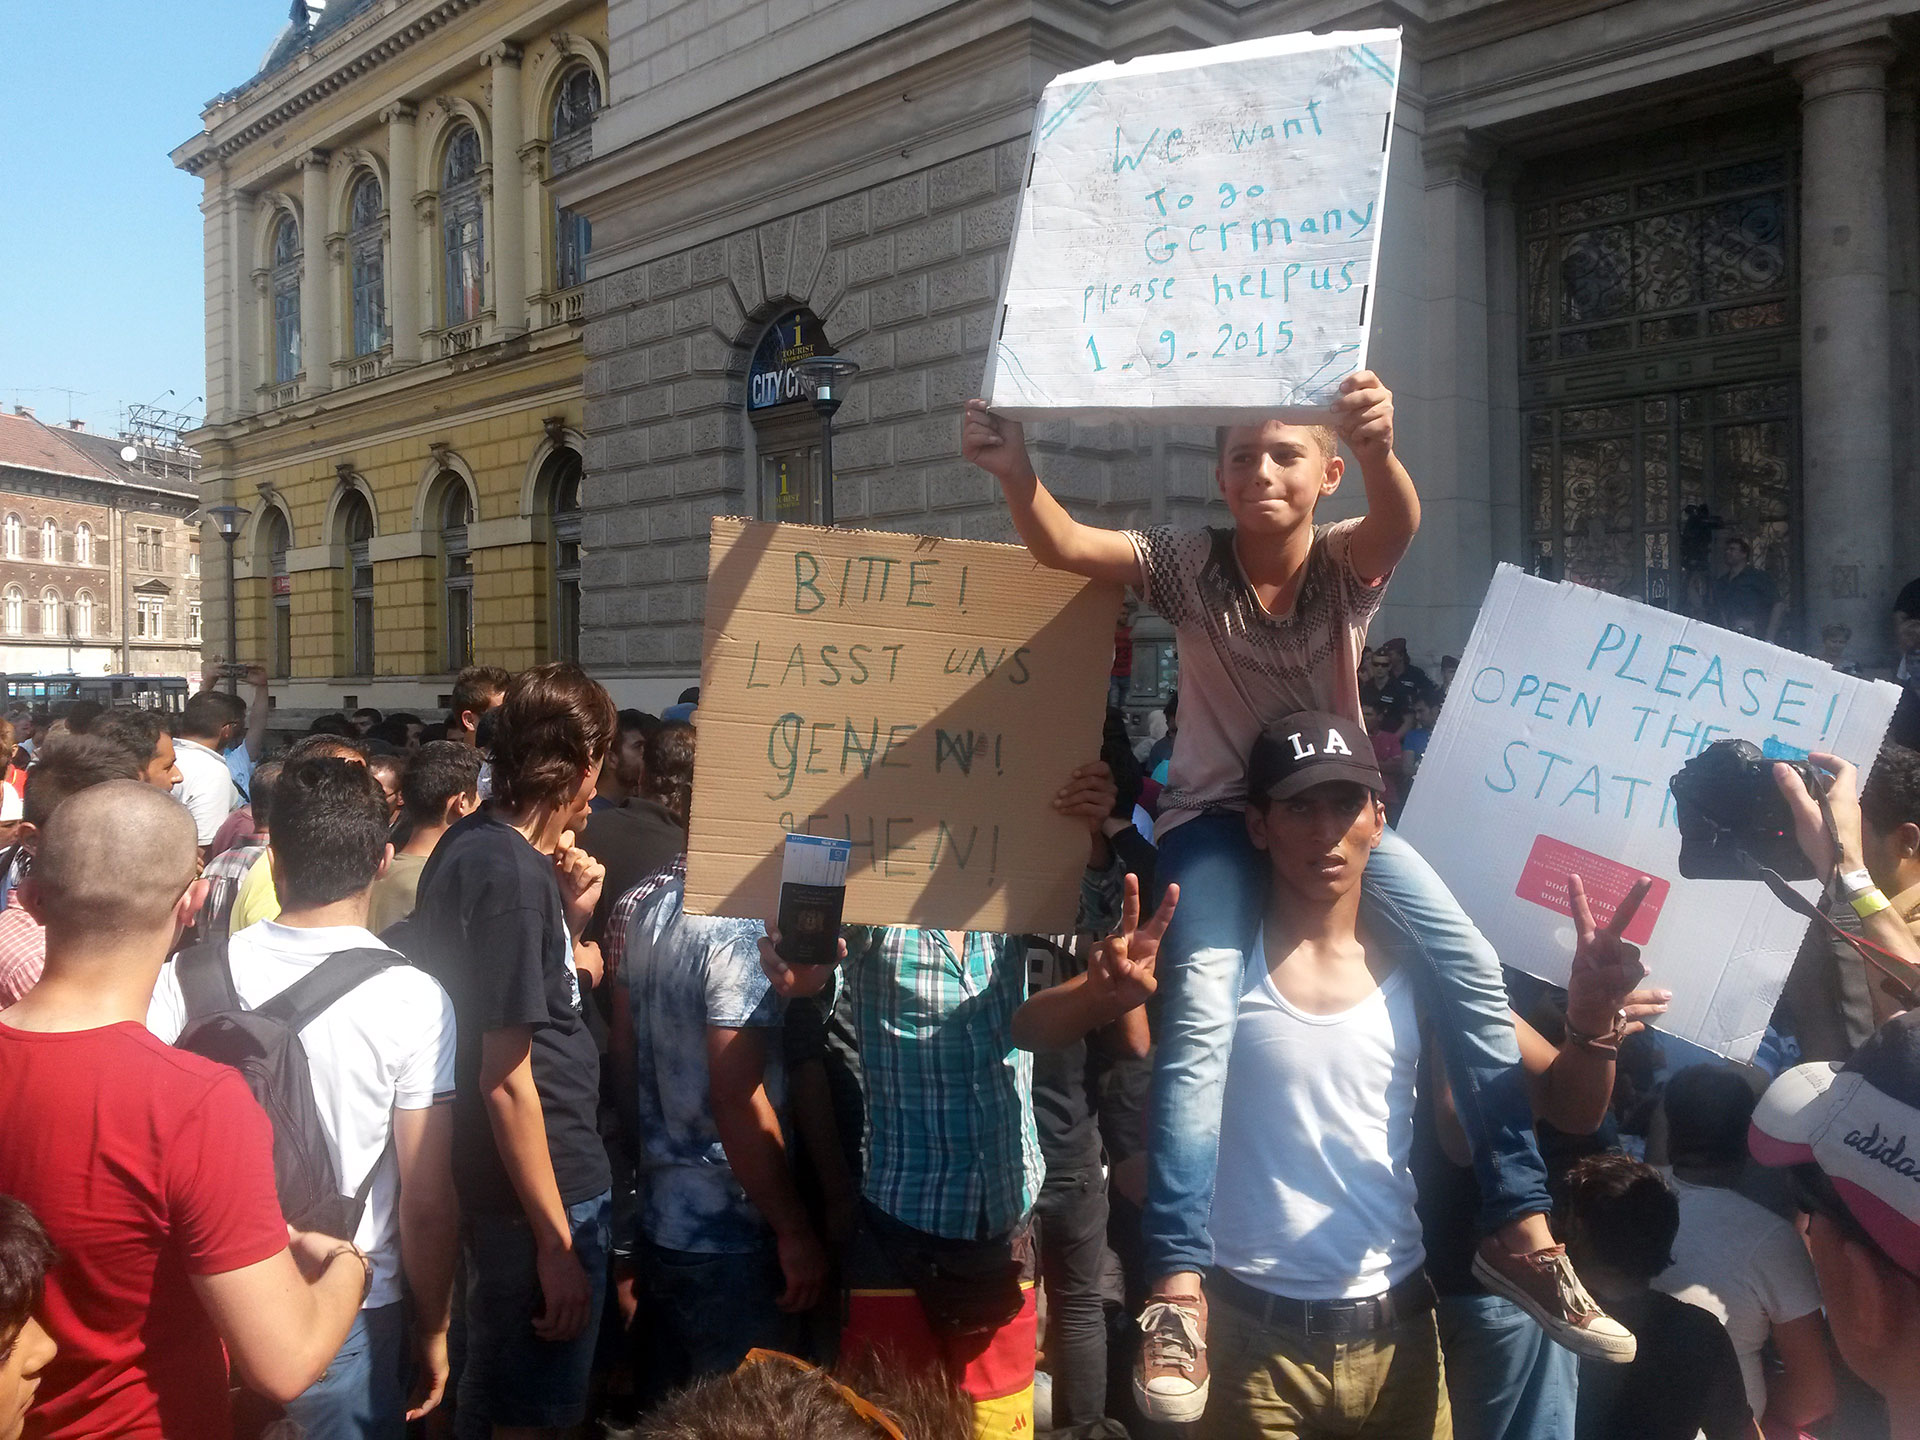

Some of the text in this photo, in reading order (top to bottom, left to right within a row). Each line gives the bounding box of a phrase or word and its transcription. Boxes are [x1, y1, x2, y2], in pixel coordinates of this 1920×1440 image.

[1112, 99, 1323, 174] We want
[1145, 182, 1265, 217] To go
[1145, 200, 1374, 265] Germany
[1082, 276, 1177, 324] please
[781, 344, 815, 358] TOURIST
[752, 369, 784, 404] CITY
[746, 640, 905, 690] LASST
[1471, 667, 1602, 728] OPEN
[1287, 728, 1353, 761] LA
[1484, 740, 1679, 828] STATI
